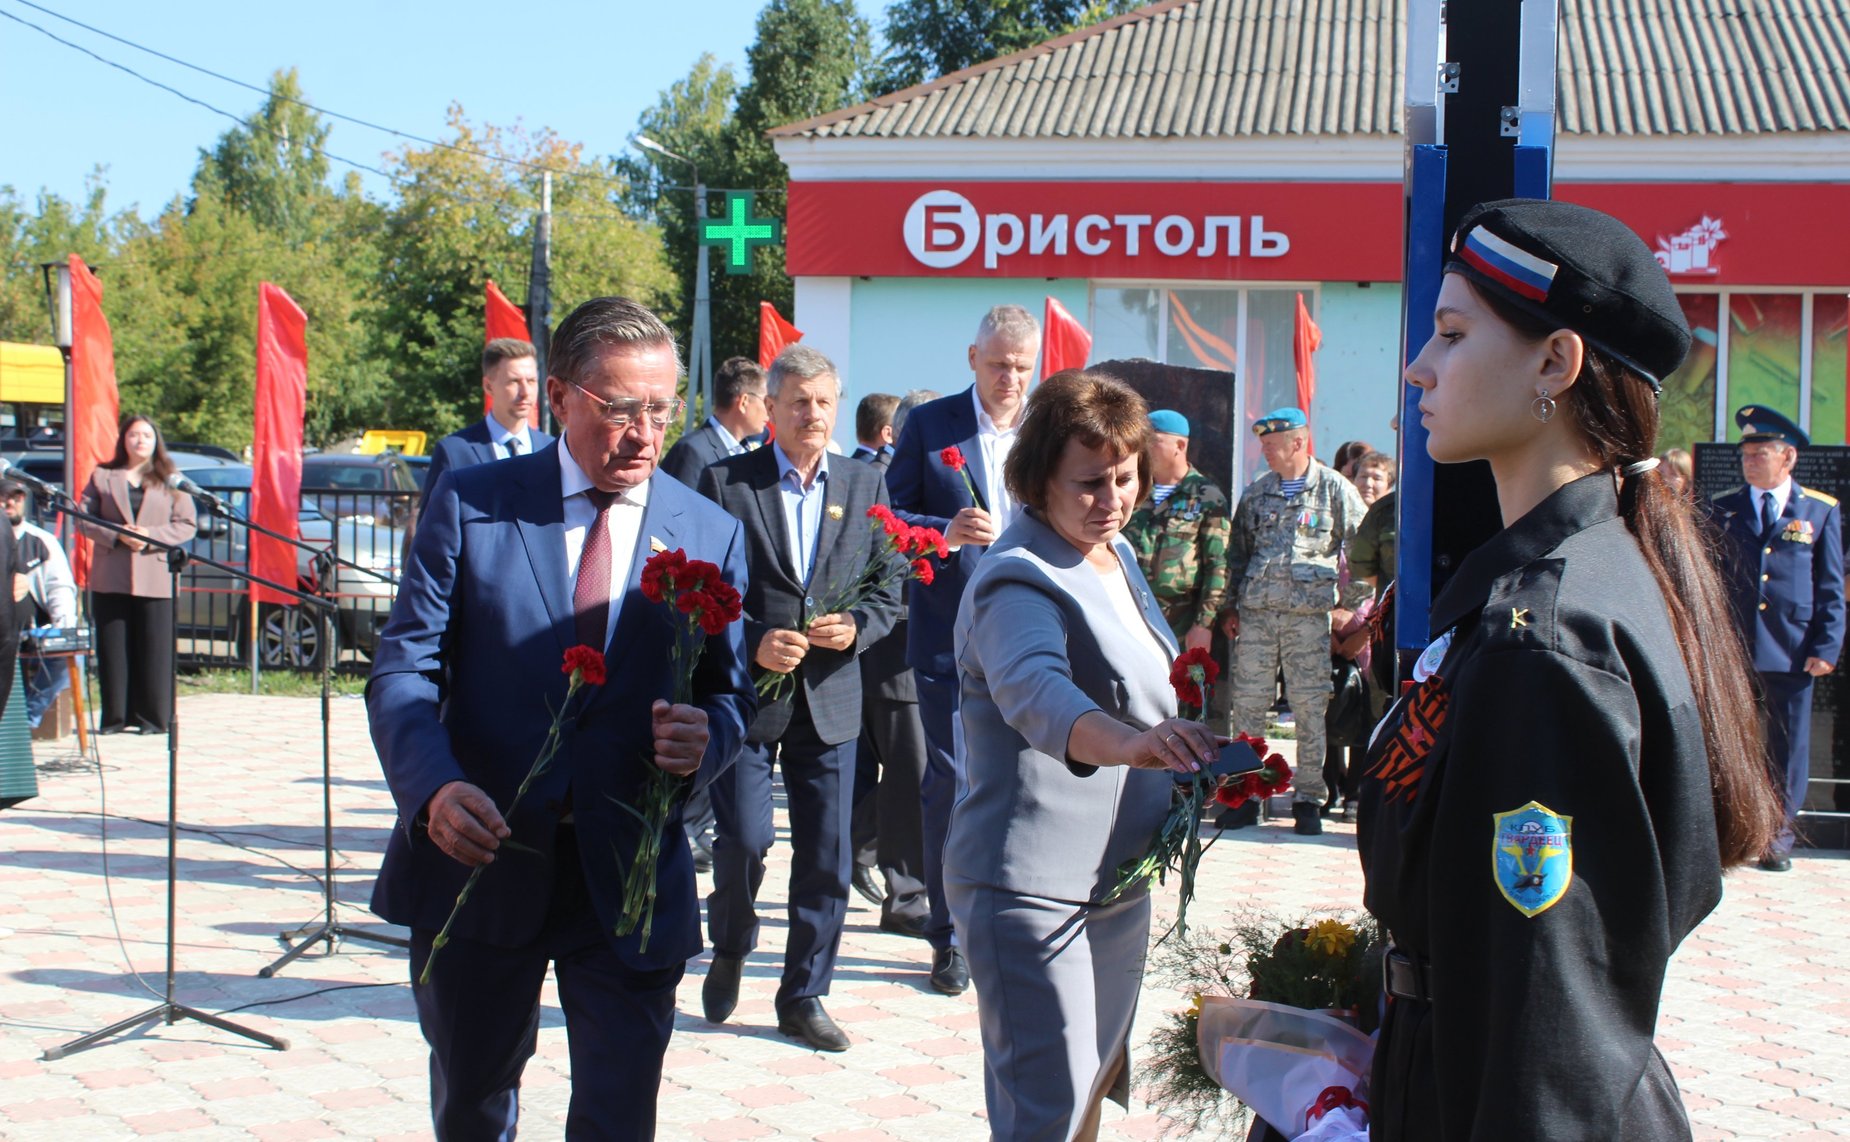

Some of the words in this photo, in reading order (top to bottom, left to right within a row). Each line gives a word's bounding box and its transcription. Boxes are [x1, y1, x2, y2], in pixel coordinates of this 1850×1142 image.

[904, 190, 1290, 269] Бристоль
[1510, 824, 1556, 834] КЛУБ
[1501, 833, 1563, 847] ГВАРДЕЕЦ
